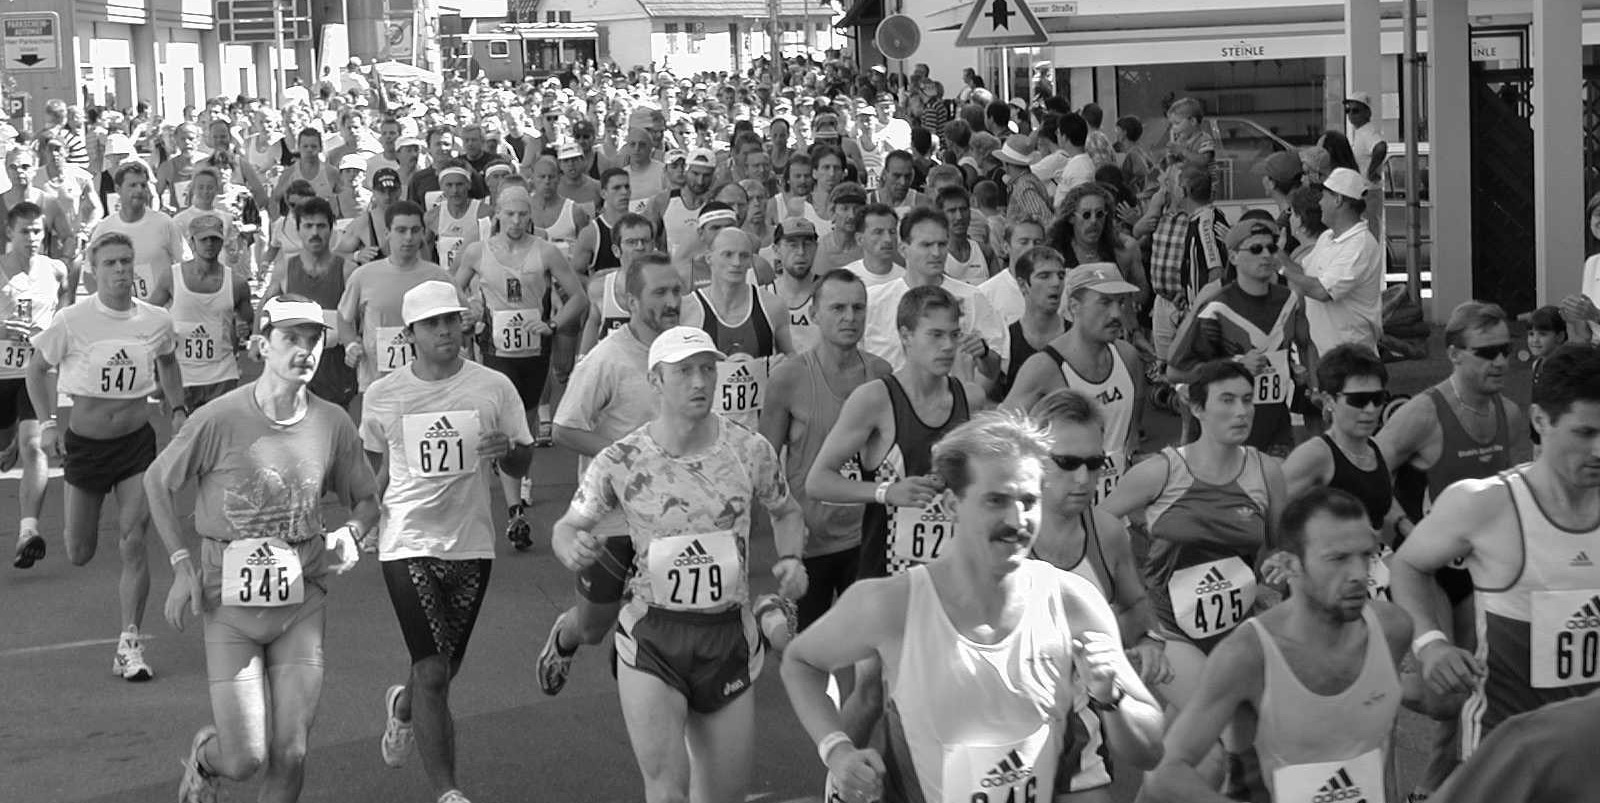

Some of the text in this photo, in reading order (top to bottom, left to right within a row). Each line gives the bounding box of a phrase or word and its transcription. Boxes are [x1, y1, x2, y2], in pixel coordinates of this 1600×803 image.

[1221, 46, 1265, 57] STEINLE
[11, 100, 23, 114] P
[185, 338, 214, 359] 536
[503, 328, 531, 349] 351
[101, 366, 137, 392] 547
[1259, 374, 1280, 401] 68
[722, 381, 759, 411] 582
[424, 430, 459, 439] adidas
[420, 438, 464, 474] 621
[912, 523, 955, 559] 62
[674, 555, 714, 568] adidas
[239, 566, 290, 603] 345
[667, 564, 723, 605] 279
[1194, 588, 1243, 633] 425
